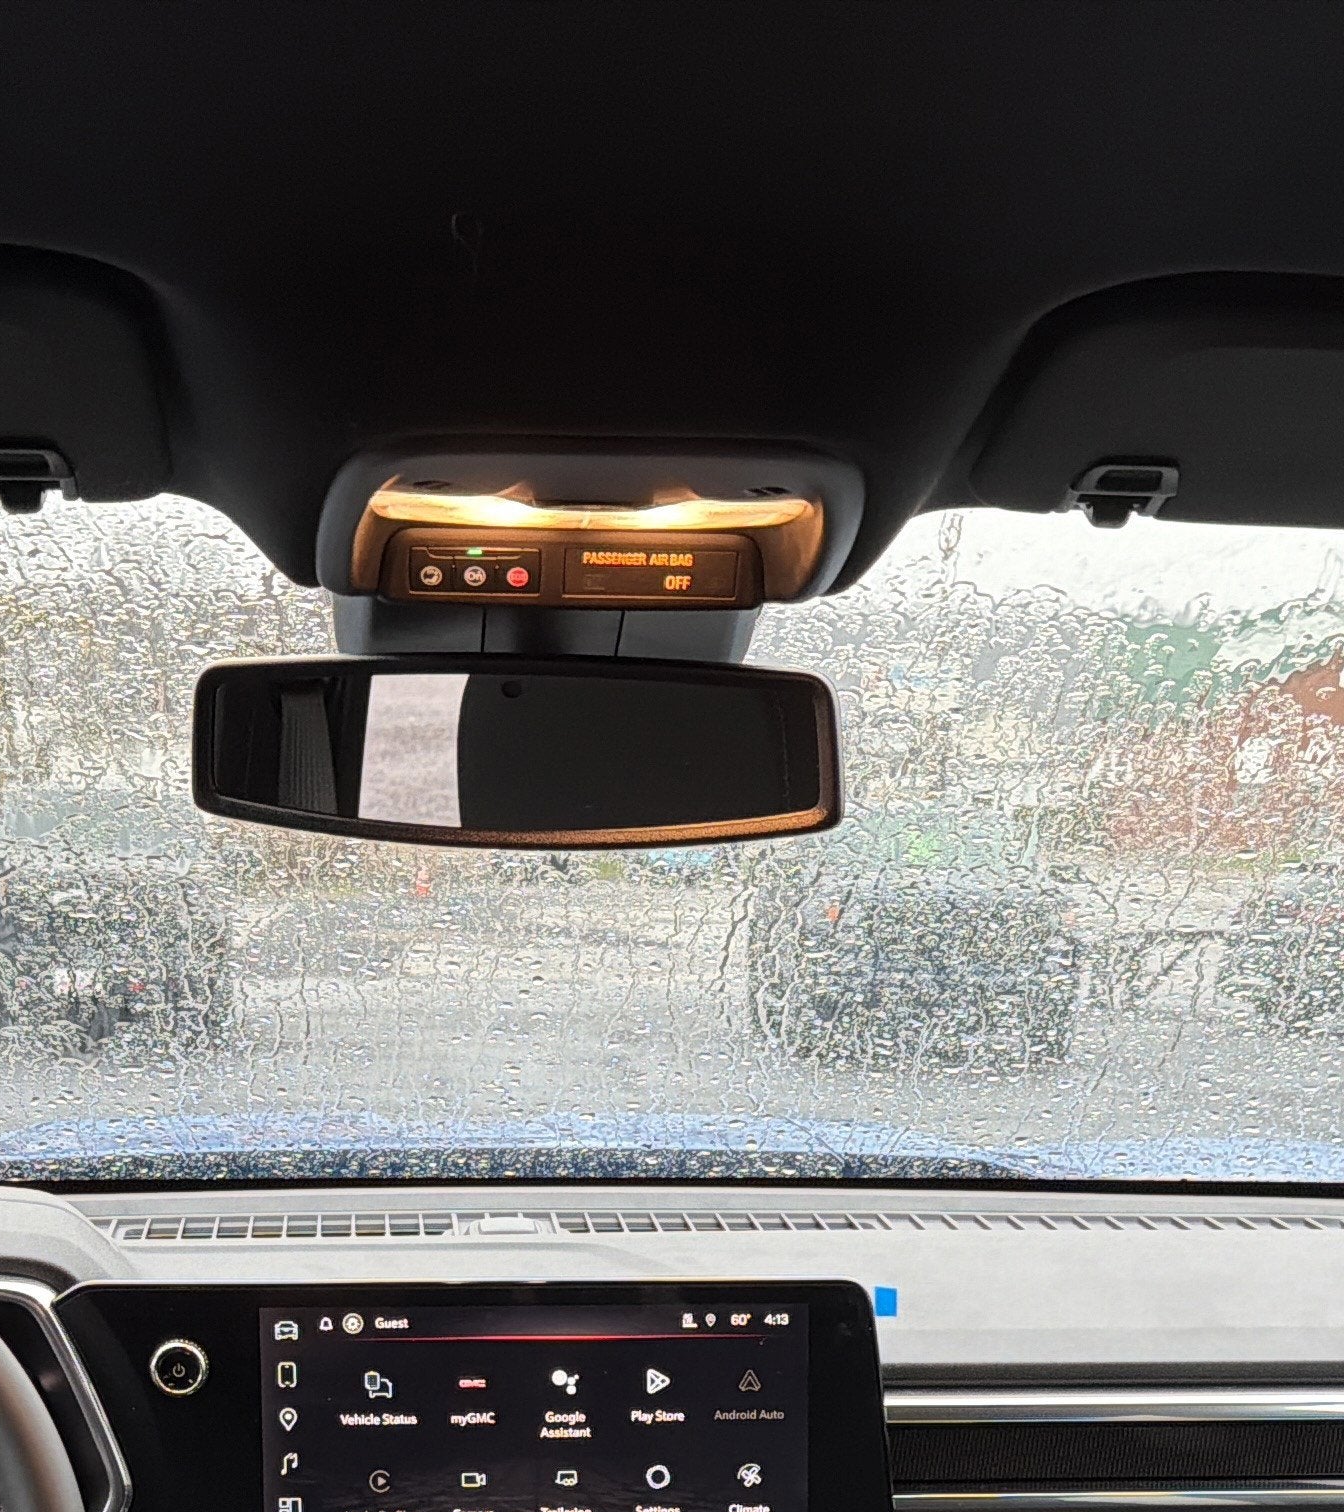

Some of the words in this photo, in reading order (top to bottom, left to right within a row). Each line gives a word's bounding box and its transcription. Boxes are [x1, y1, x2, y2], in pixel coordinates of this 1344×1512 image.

[582, 551, 647, 566] PASSENGER
[649, 553, 669, 566] AIR
[670, 554, 693, 567] BAG
[665, 575, 691, 590] OFF
[374, 1318, 409, 1329] Guest
[730, 1313, 752, 1326] 60°
[764, 1314, 789, 1326] 4:13
[339, 1414, 380, 1426] Vehicle
[382, 1413, 418, 1425] Status
[450, 1412, 496, 1427] myGMC
[545, 1411, 586, 1425] Google
[631, 1410, 653, 1425] Play
[655, 1410, 685, 1422] Store
[714, 1410, 757, 1420] Android
[759, 1410, 785, 1420] Auto
[540, 1427, 591, 1439] Assistant
